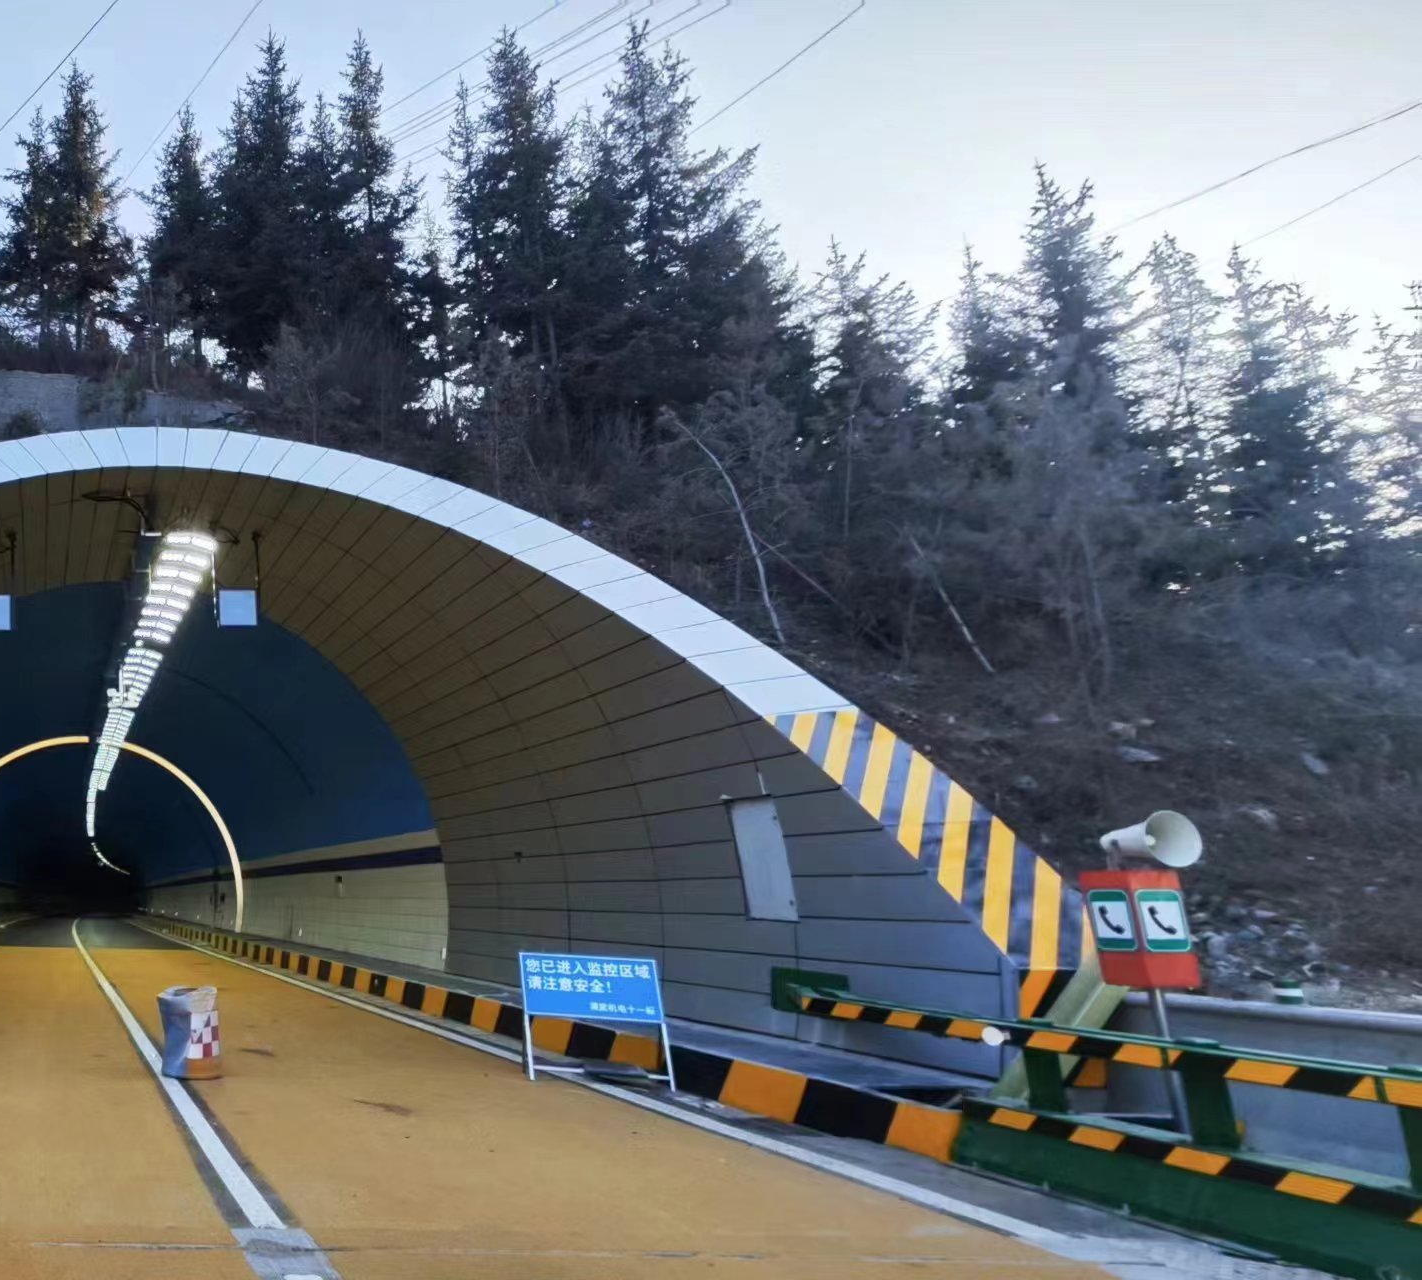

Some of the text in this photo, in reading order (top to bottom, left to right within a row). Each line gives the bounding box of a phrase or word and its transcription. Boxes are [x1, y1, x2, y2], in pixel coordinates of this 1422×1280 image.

[524, 958, 651, 979] 您已进入监控区域
[527, 976, 612, 993] 请注意安全！
